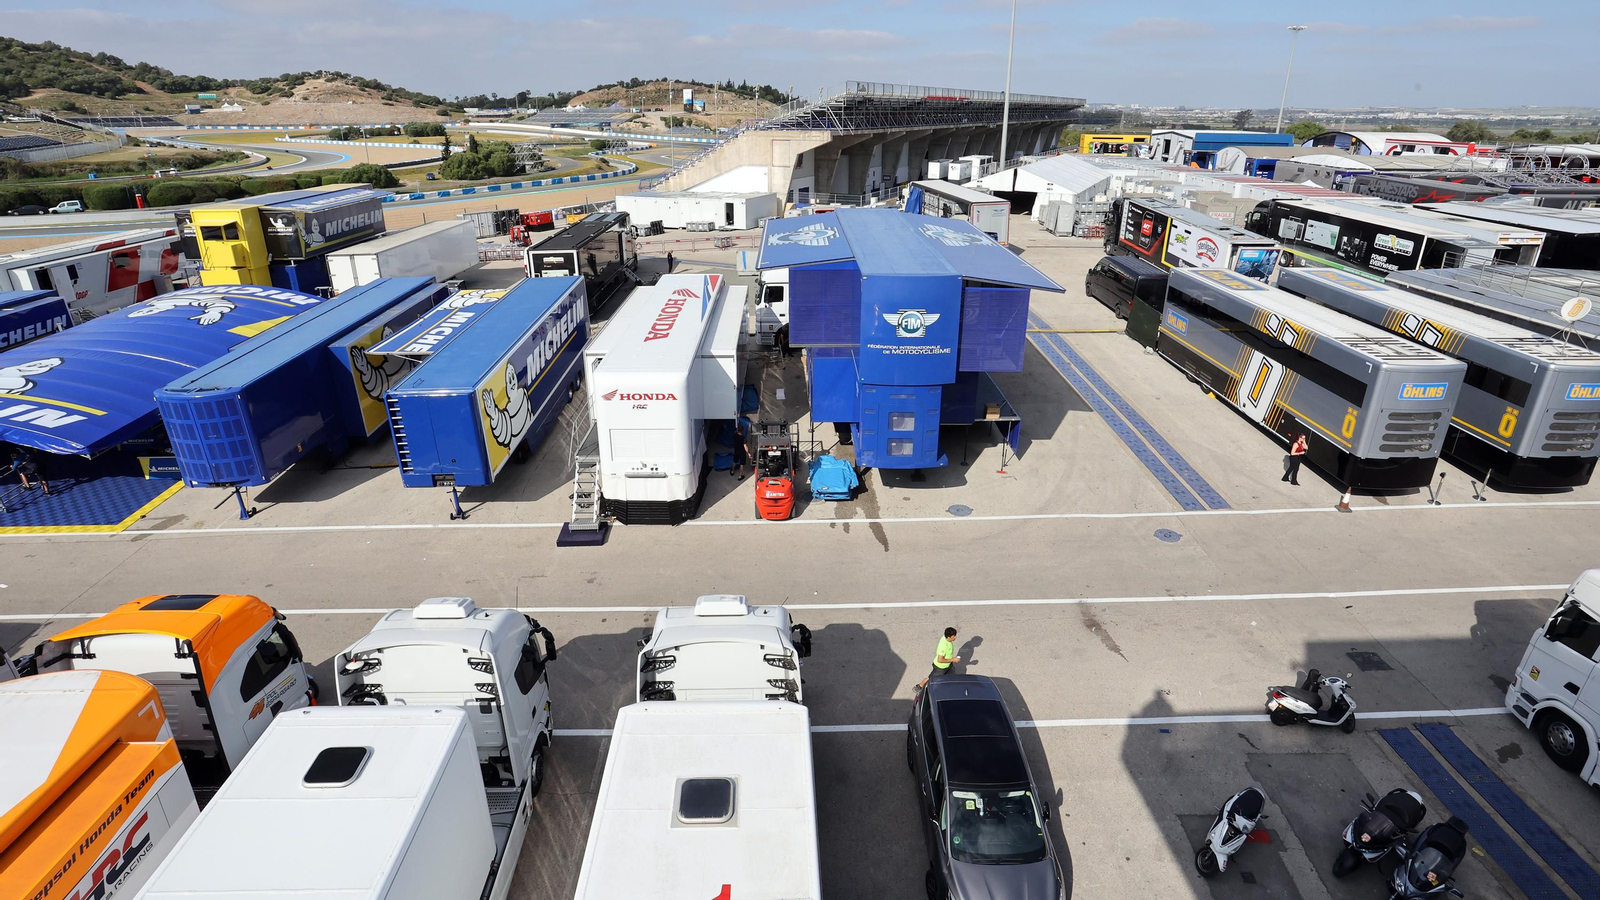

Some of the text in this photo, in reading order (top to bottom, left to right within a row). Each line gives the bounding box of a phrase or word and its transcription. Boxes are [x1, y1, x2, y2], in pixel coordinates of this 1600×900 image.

[1368, 180, 1420, 198] ALPINESTARS
[325, 209, 383, 237] MICHELIN
[1377, 236, 1411, 250] Green Power
[1370, 259, 1399, 270] EVERYWHERE
[1371, 253, 1388, 263] POWER
[643, 298, 687, 342] HONDA
[902, 317, 921, 330] FIM
[1167, 311, 1187, 332] ÖHLINS
[526, 295, 584, 386] MICHELIN
[619, 393, 678, 401] HONDA
[1402, 384, 1444, 398] ÖHLINS
[1341, 406, 1358, 439] Ö
[1498, 406, 1519, 439] Ö
[266, 689, 277, 700] POL
[30, 769, 155, 900] epsol Honda Team
[115, 843, 153, 890] RACING
